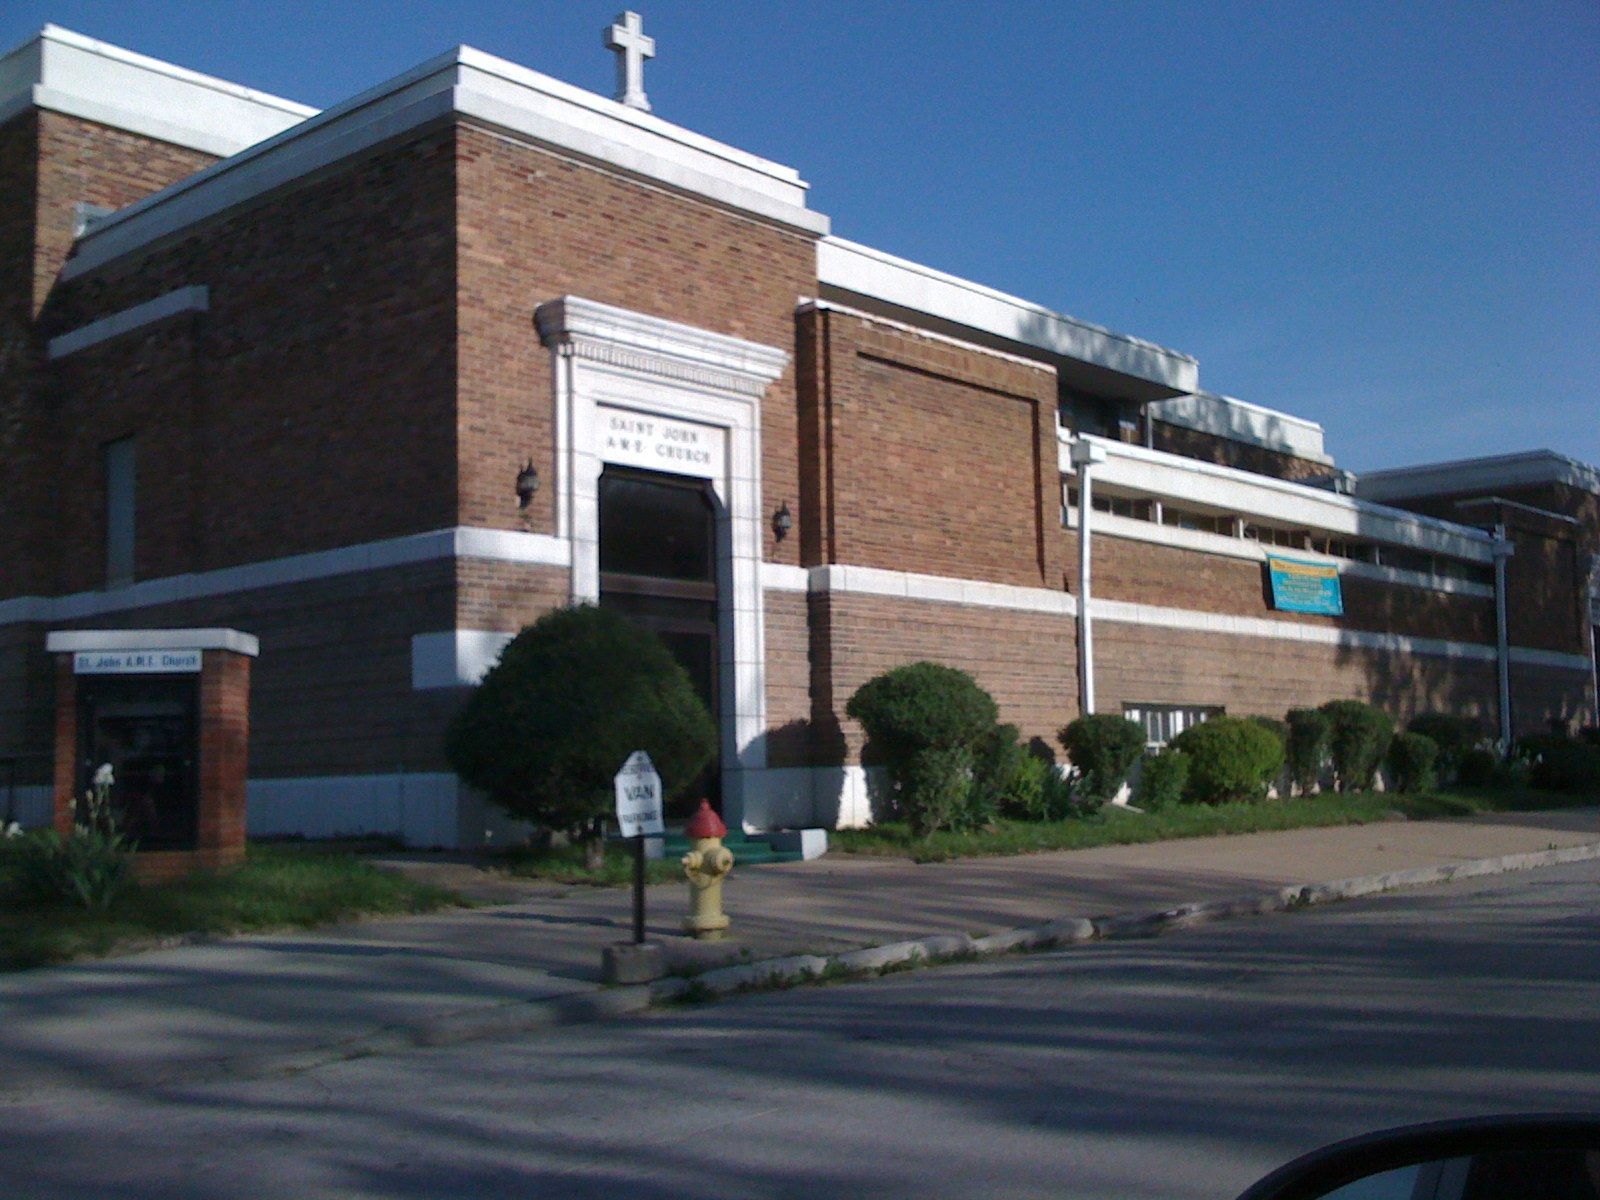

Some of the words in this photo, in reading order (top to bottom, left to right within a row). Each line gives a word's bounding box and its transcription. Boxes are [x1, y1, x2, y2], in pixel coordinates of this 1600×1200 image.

[610, 417, 653, 435] SAINT
[663, 428, 697, 442] JOHN
[655, 444, 710, 464] CHURCH
[96, 656, 121, 668] John
[162, 654, 197, 666] Church
[624, 784, 655, 801] VAN
